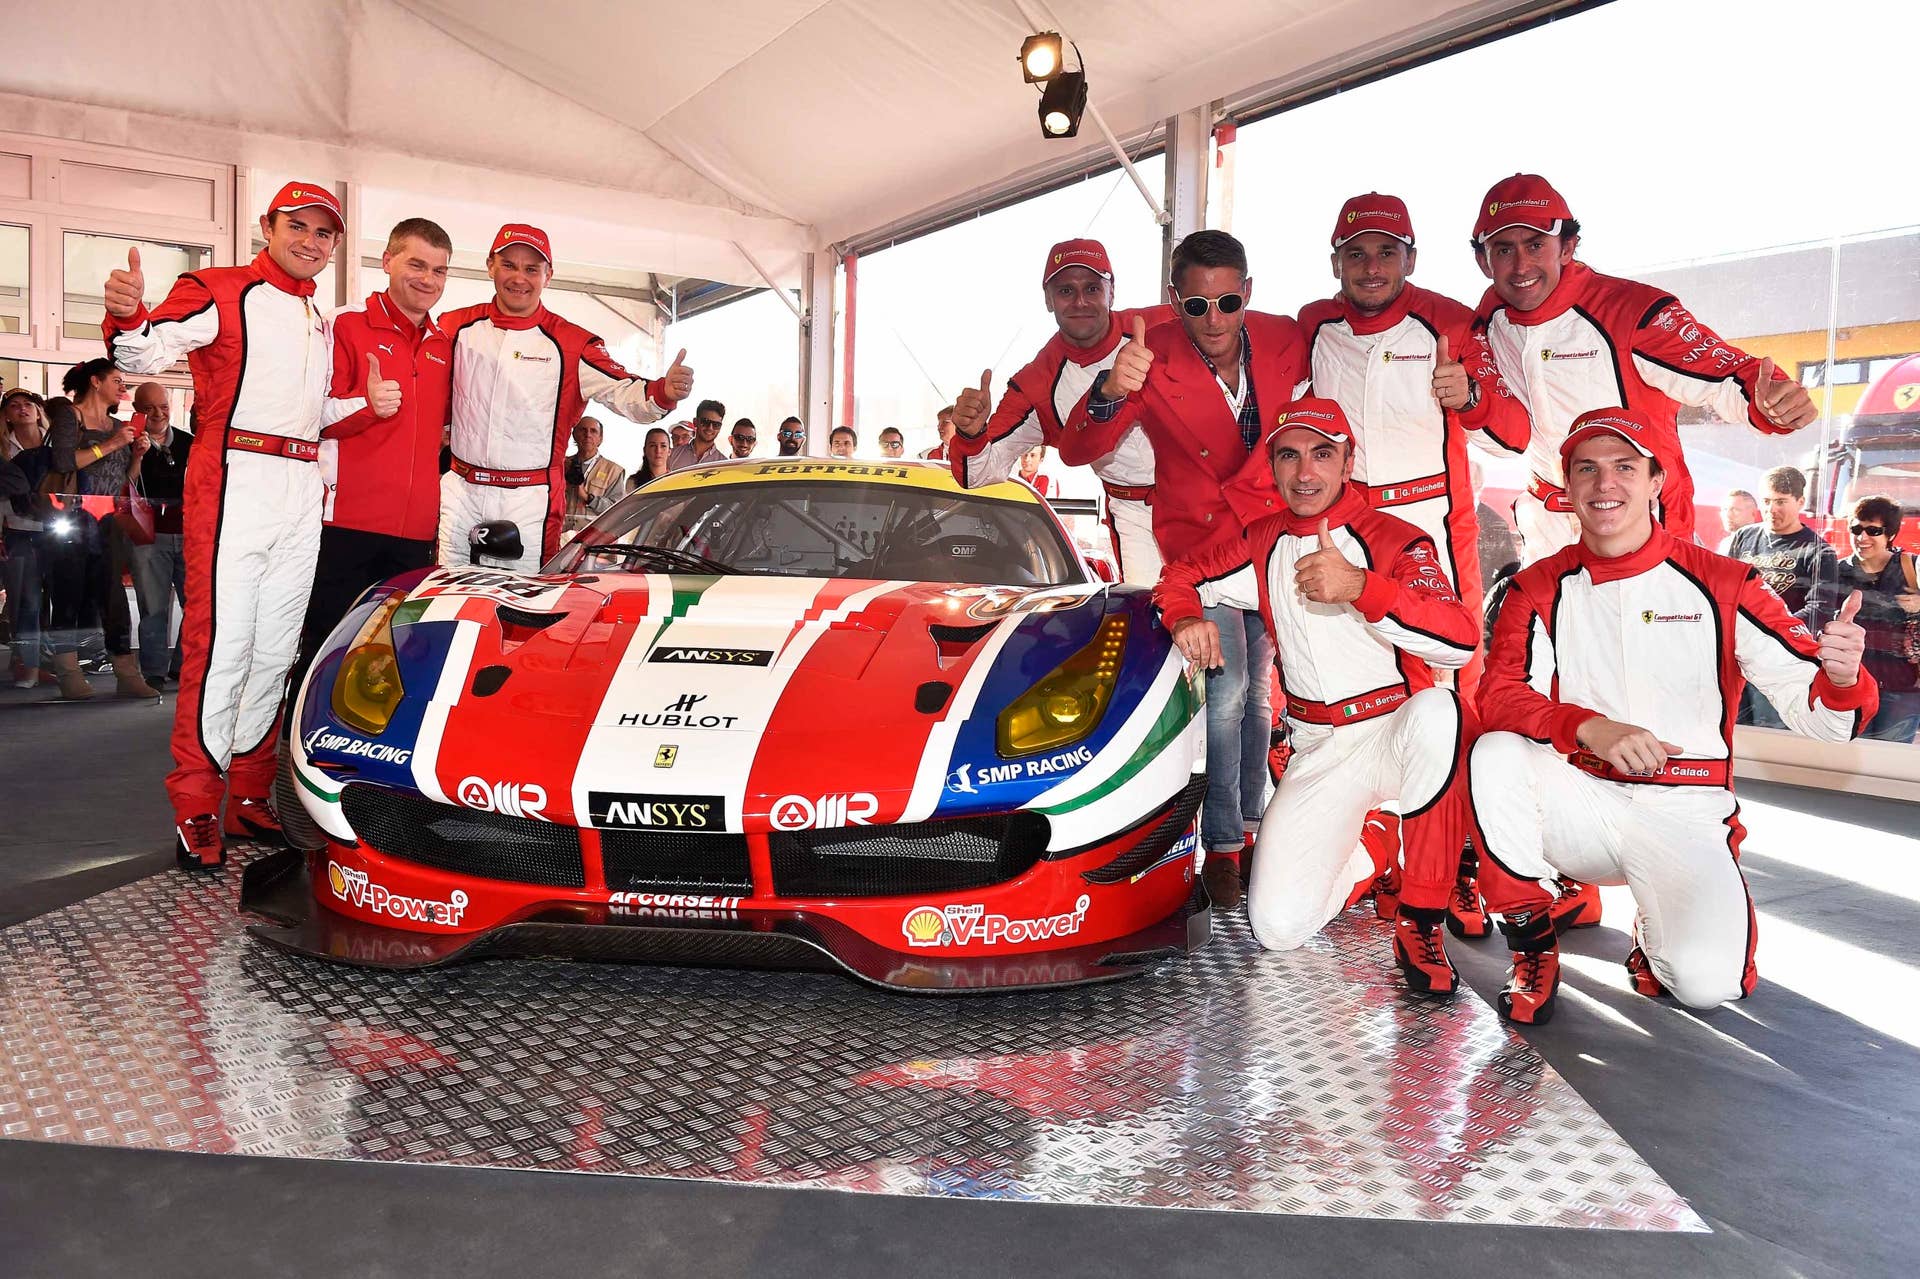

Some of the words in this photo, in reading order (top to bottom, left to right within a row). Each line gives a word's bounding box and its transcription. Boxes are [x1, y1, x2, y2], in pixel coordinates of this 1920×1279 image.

[1682, 337, 1721, 363] SING
[1477, 366, 1498, 378] SIN
[1632, 422, 1644, 432] GT
[753, 464, 909, 479] Ferrari
[1402, 489, 1411, 497] G.
[952, 546, 976, 555] OMP
[663, 650, 756, 663] ANSYS
[618, 713, 739, 729] HUBLOT
[315, 733, 351, 751] SMP
[341, 740, 412, 764] RACING
[977, 763, 1022, 785] SMP
[1026, 745, 1093, 777] RACING
[1656, 766, 1667, 775] J.
[1671, 766, 1710, 777] Calado
[606, 802, 706, 827] ANSYS
[344, 867, 367, 880] Shell
[348, 880, 462, 925] V-Power
[608, 891, 745, 909] AFCORSE.IT
[946, 906, 982, 915] Shell
[951, 911, 1083, 943] V-Power
